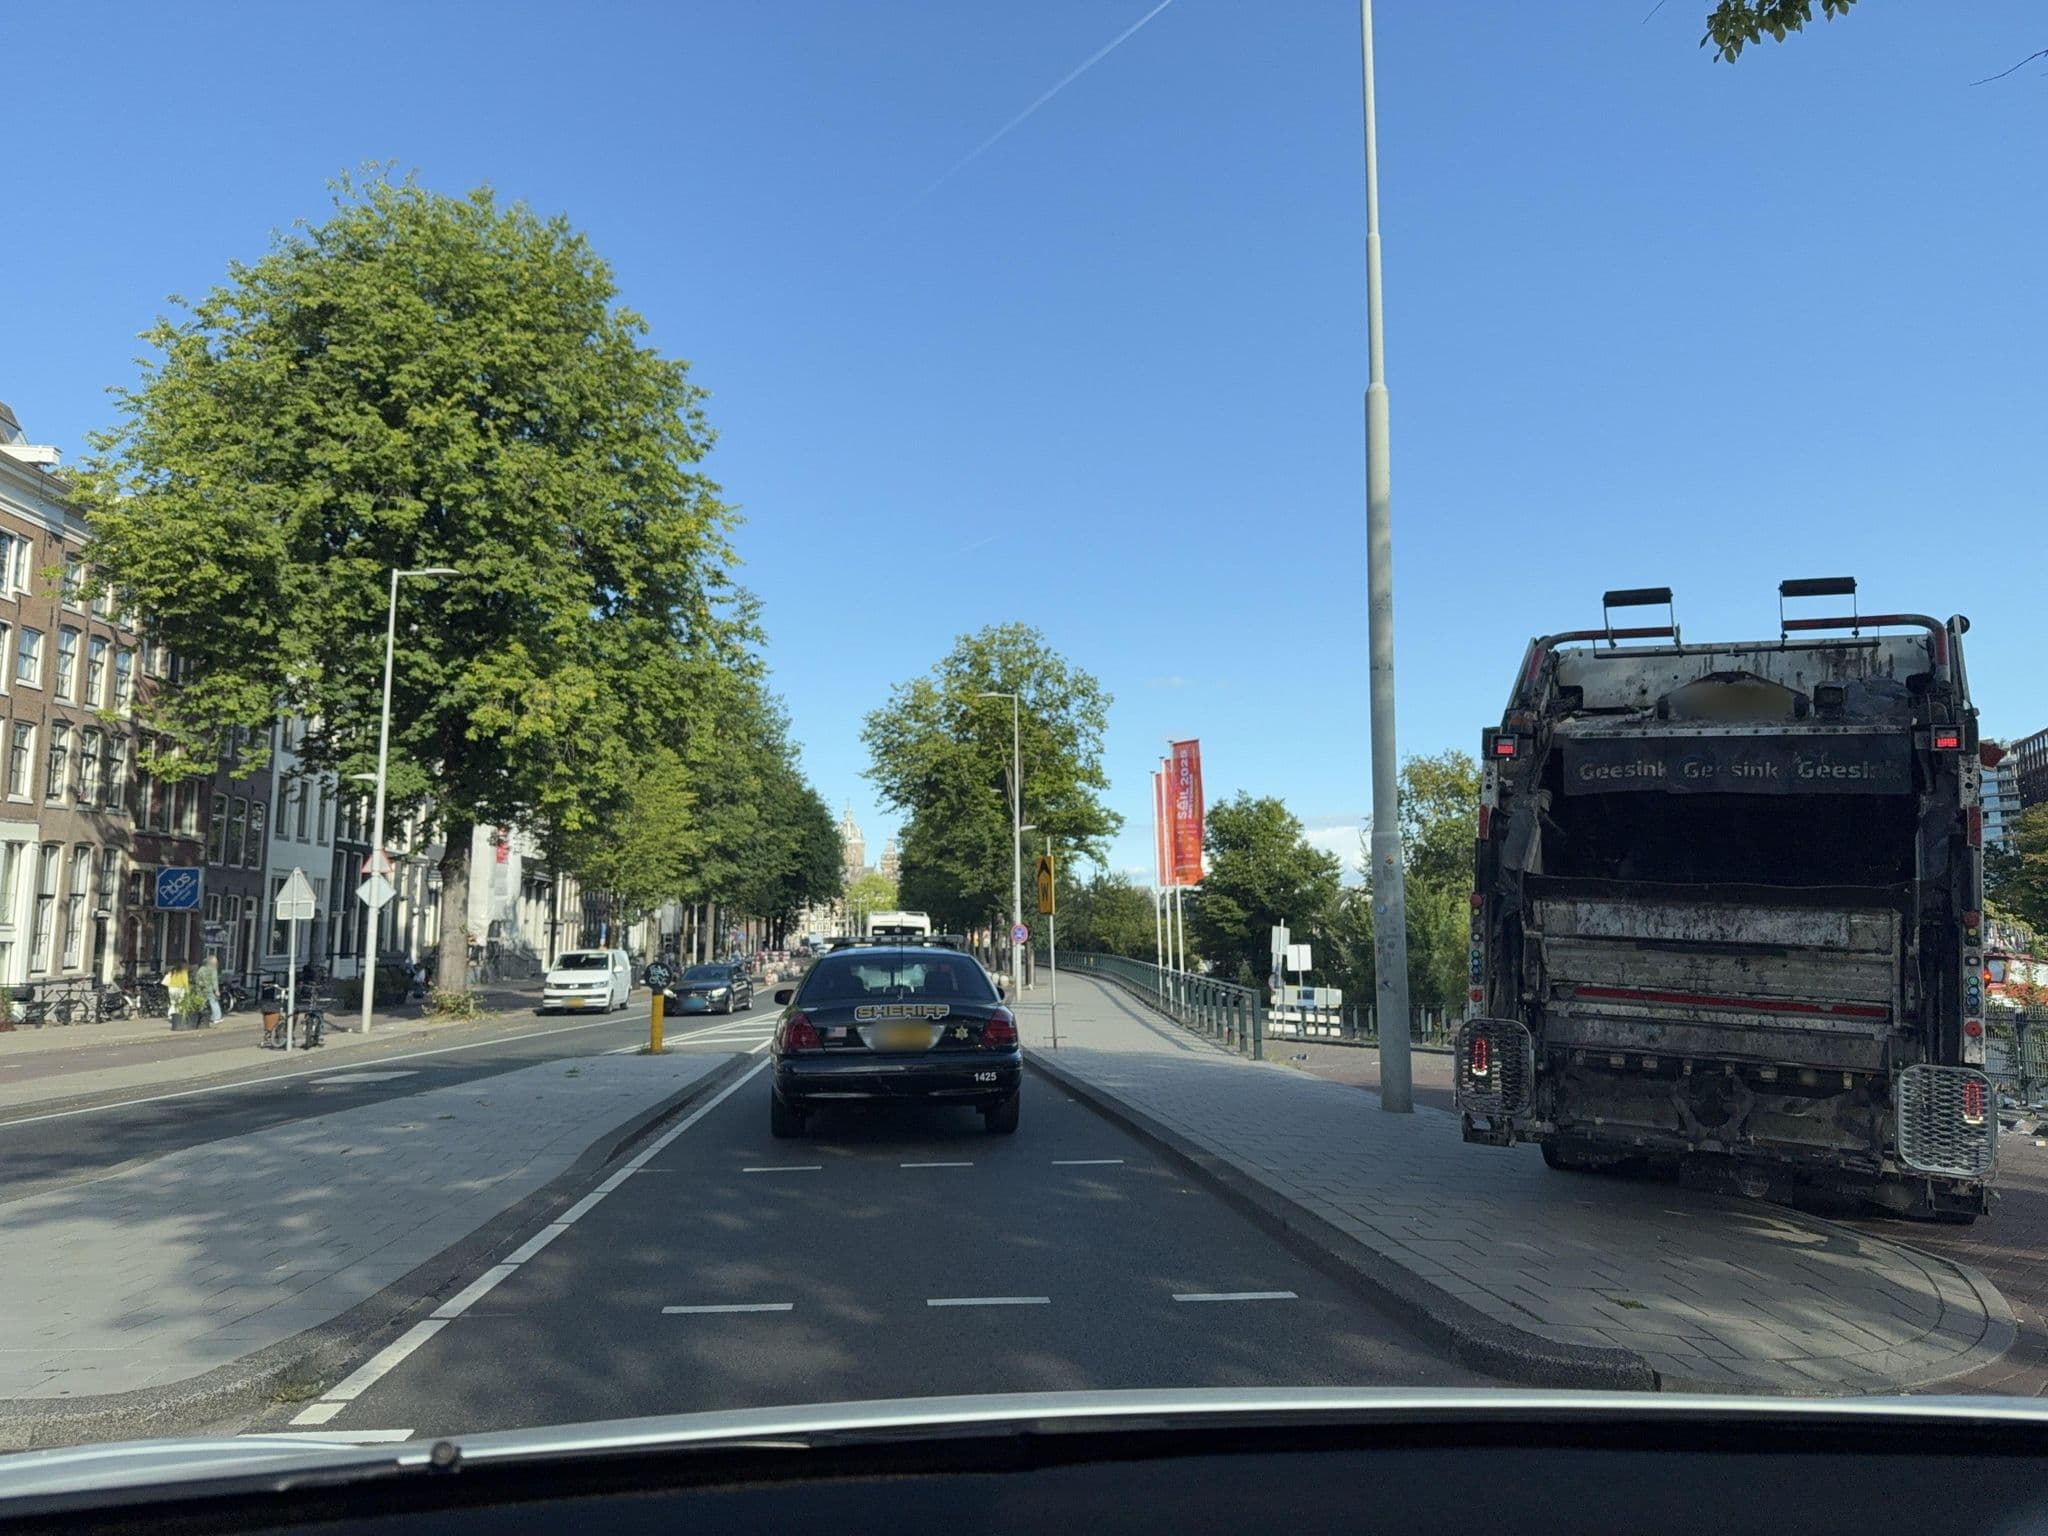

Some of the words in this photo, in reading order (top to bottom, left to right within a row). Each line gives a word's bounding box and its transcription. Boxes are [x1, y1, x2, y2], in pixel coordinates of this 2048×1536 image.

[1176, 789, 1189, 820] SAIL
[857, 1005, 949, 1019] SHERIFF
[974, 1072, 997, 1082] 1425
